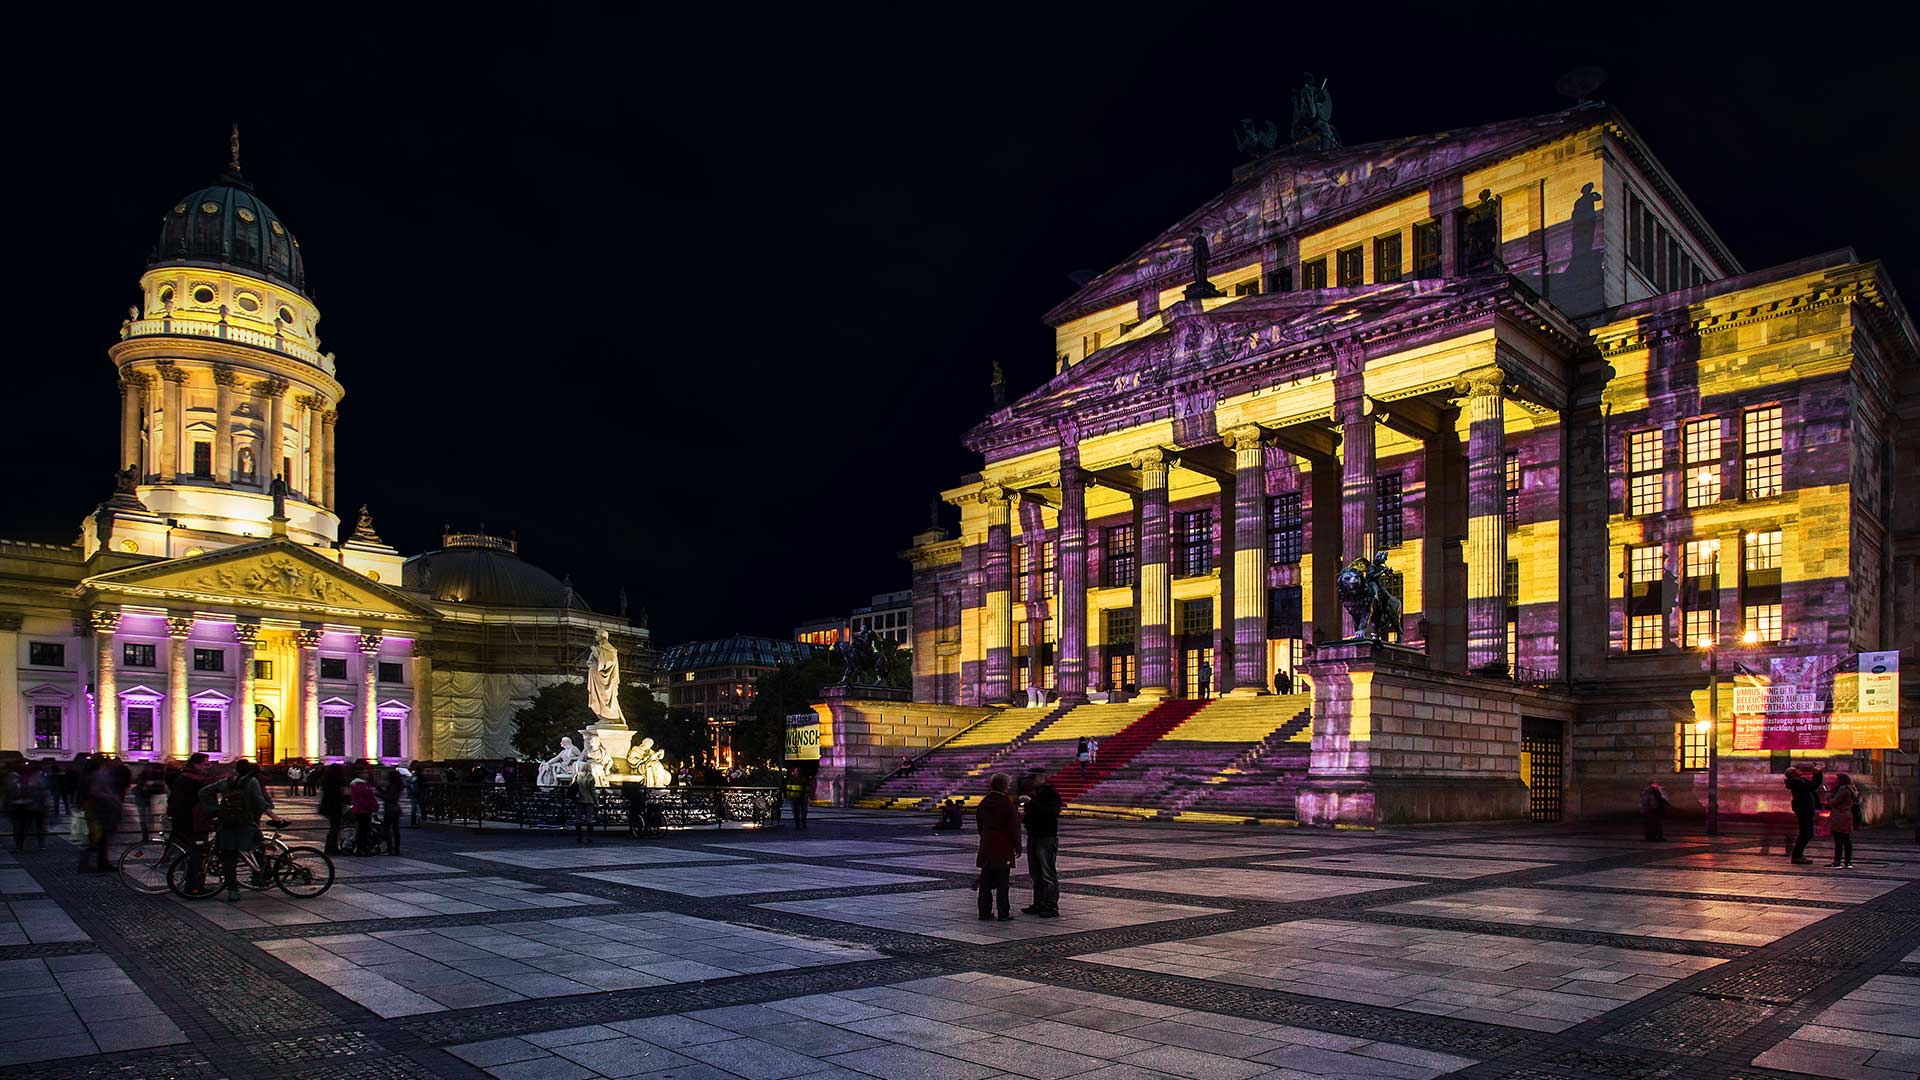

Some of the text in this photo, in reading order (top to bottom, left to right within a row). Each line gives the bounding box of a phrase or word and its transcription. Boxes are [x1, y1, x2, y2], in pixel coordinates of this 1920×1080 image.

[1060, 356, 1361, 446] KONZERTHAUS BERLIN
[1736, 695, 1784, 704] BELEUCHTUNG
[1746, 703, 1795, 711] KONZERTHAUS
